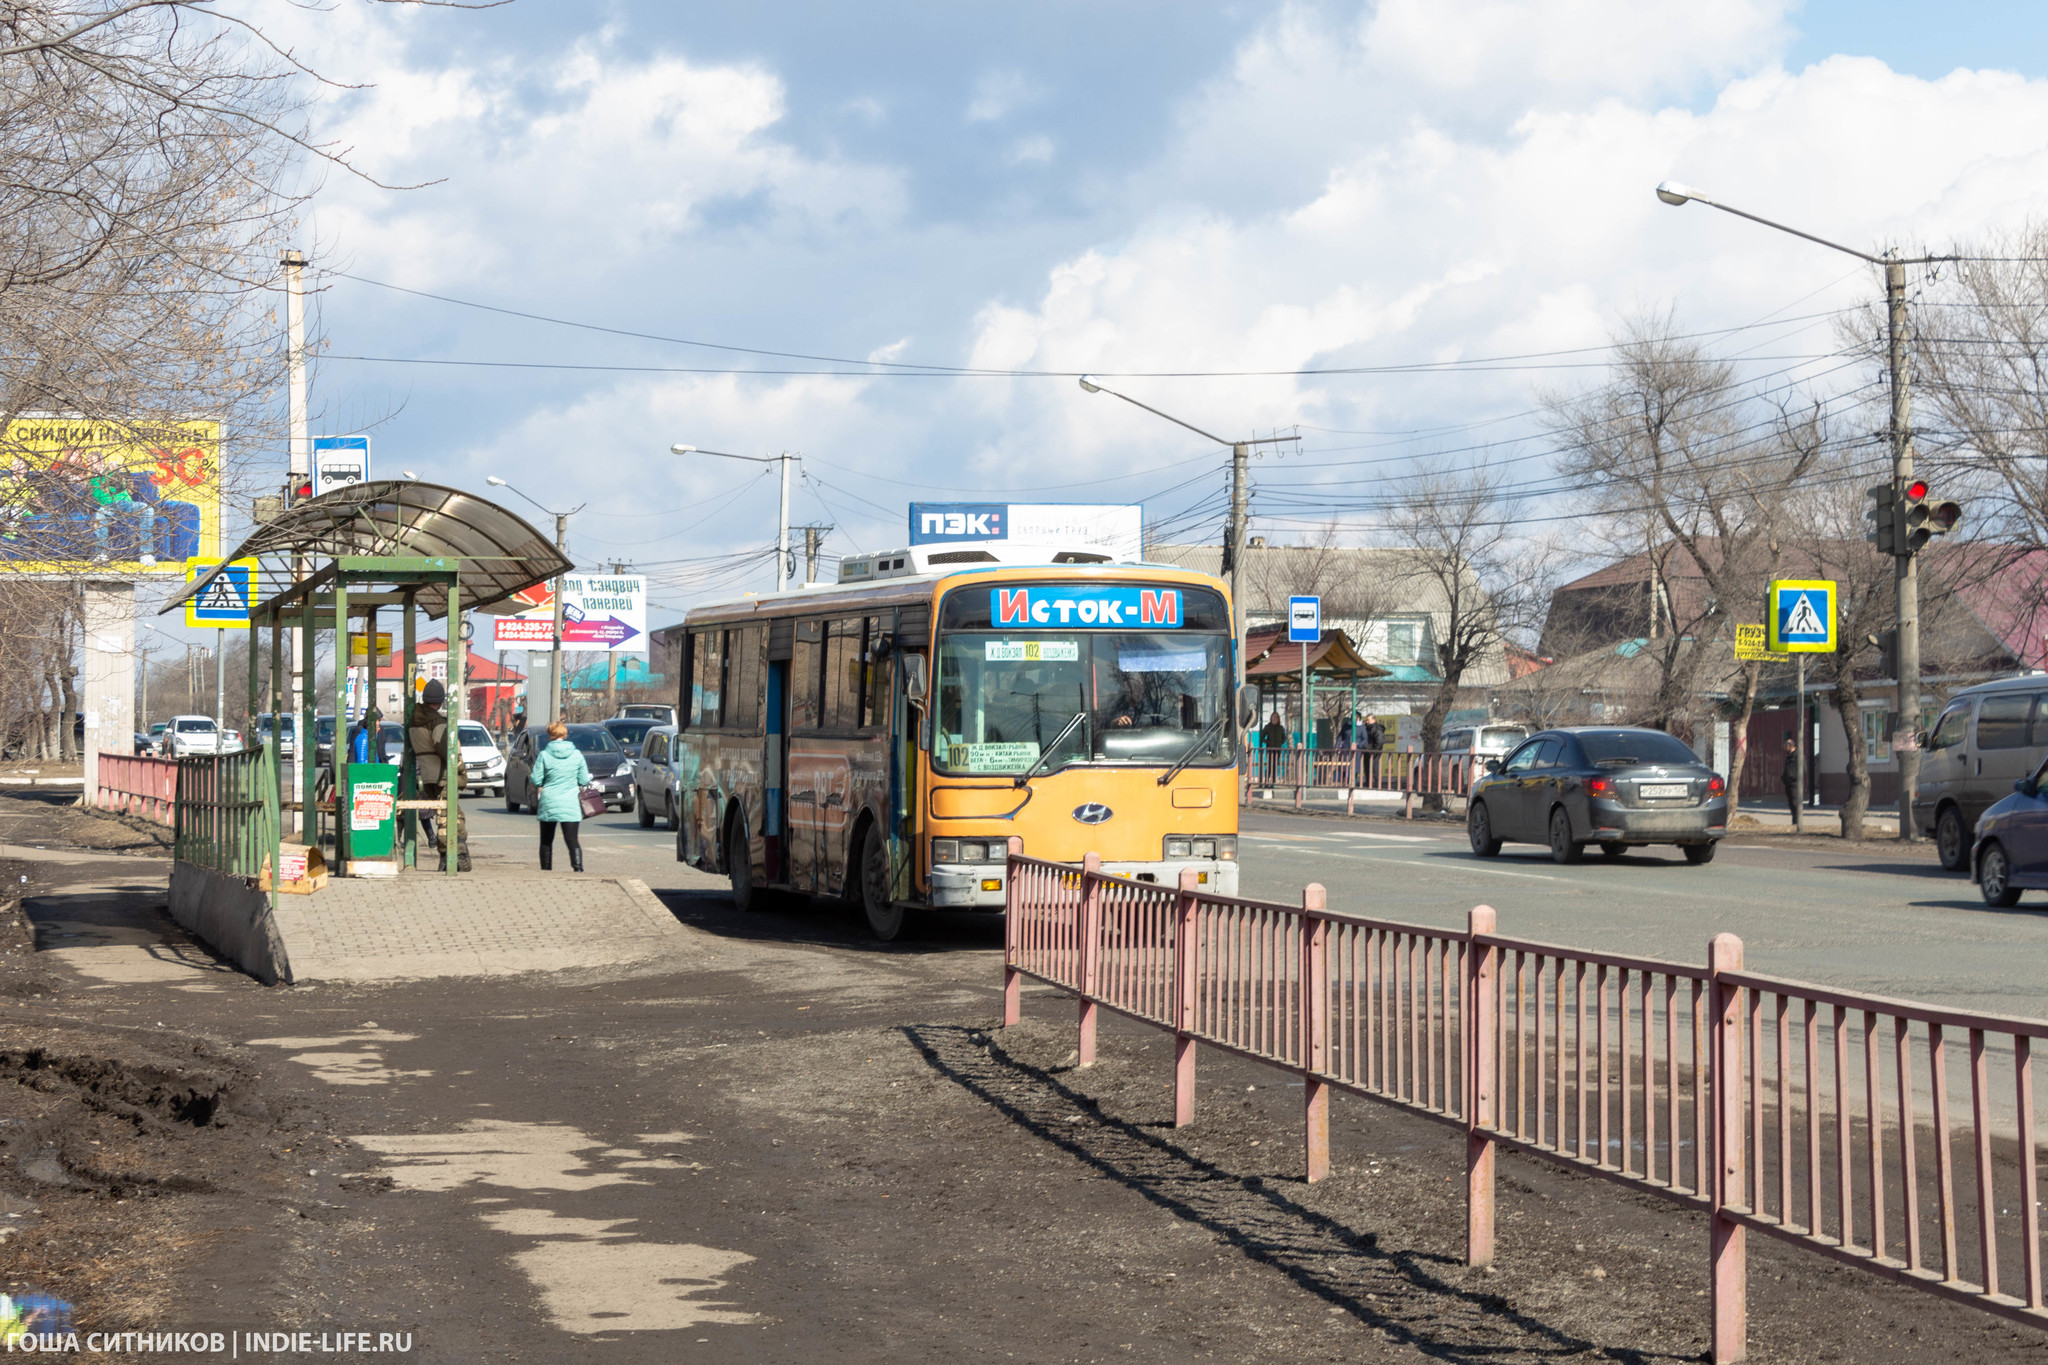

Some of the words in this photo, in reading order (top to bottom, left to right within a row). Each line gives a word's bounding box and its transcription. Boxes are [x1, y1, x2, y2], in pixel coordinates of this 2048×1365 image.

[16, 427, 93, 443] СКИДКИ
[1025, 643, 1040, 659] 102
[948, 747, 969, 767] 102
